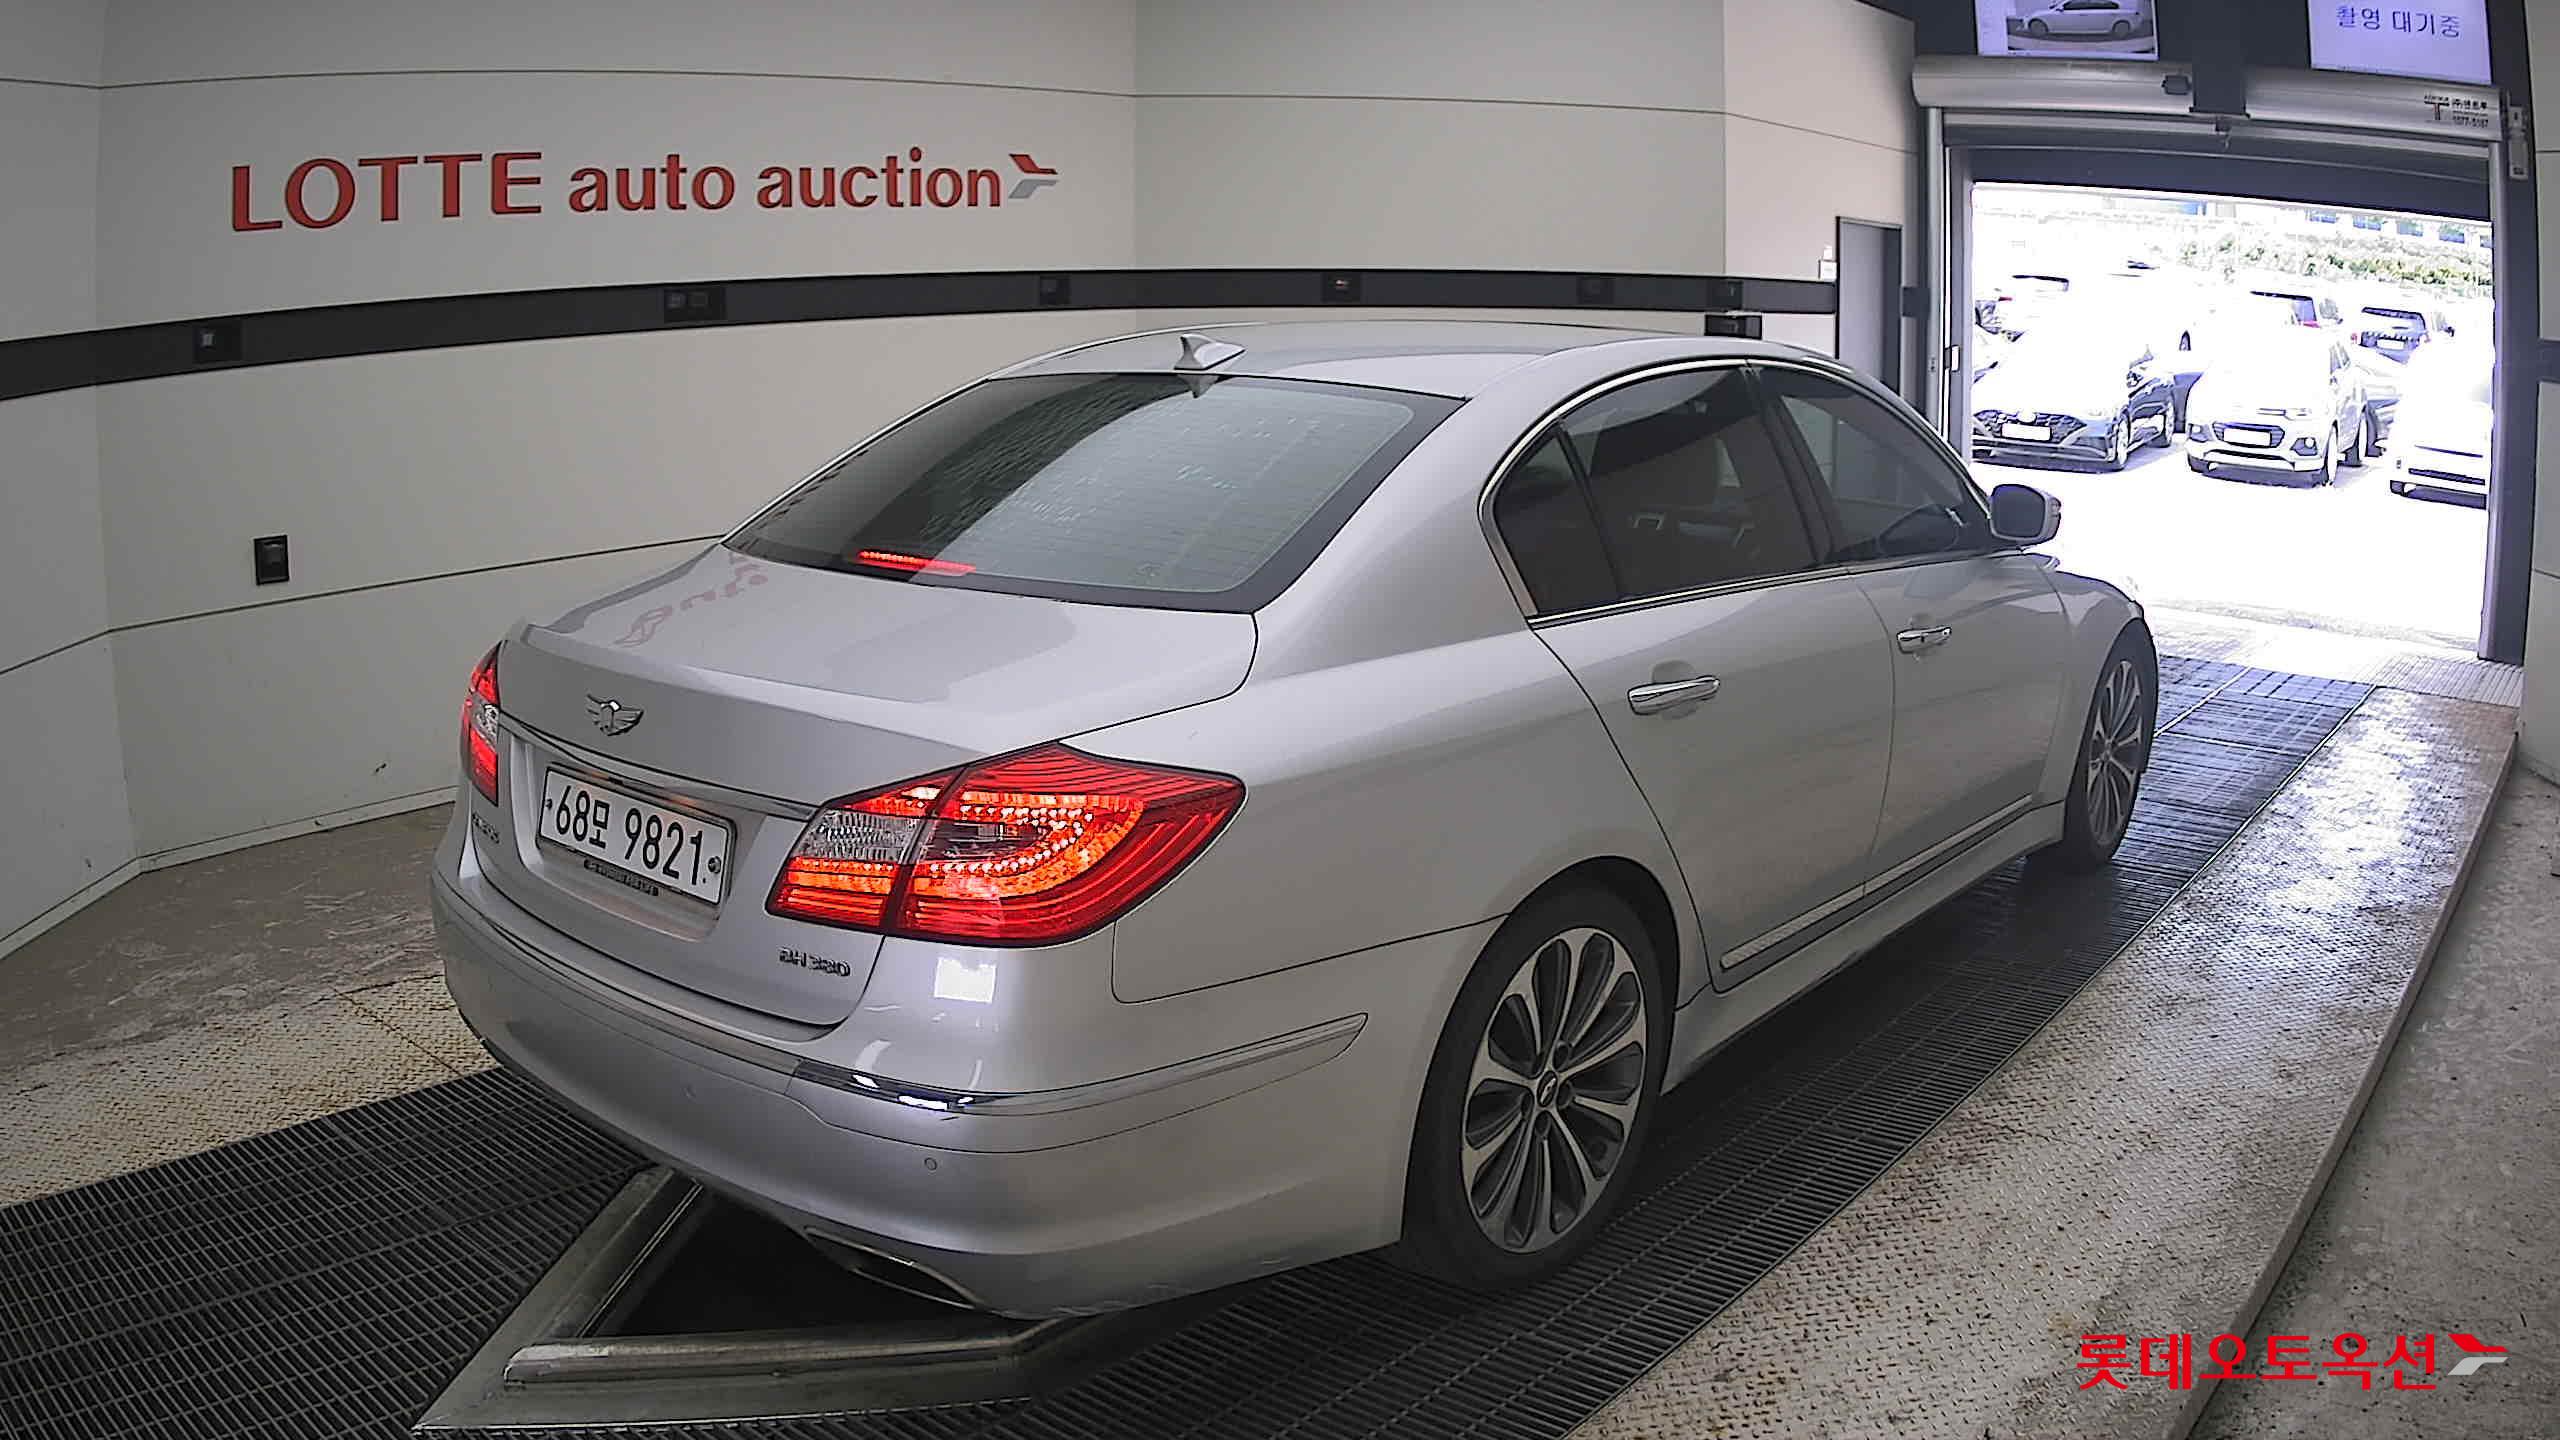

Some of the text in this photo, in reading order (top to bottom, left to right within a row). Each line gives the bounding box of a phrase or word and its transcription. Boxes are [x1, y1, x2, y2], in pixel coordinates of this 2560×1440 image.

[2335, 5, 2461, 39] 촬영 대기중
[231, 146, 1002, 233] LOTTE auto auction
[555, 784, 611, 850] 68모
[623, 807, 704, 887] 9821
